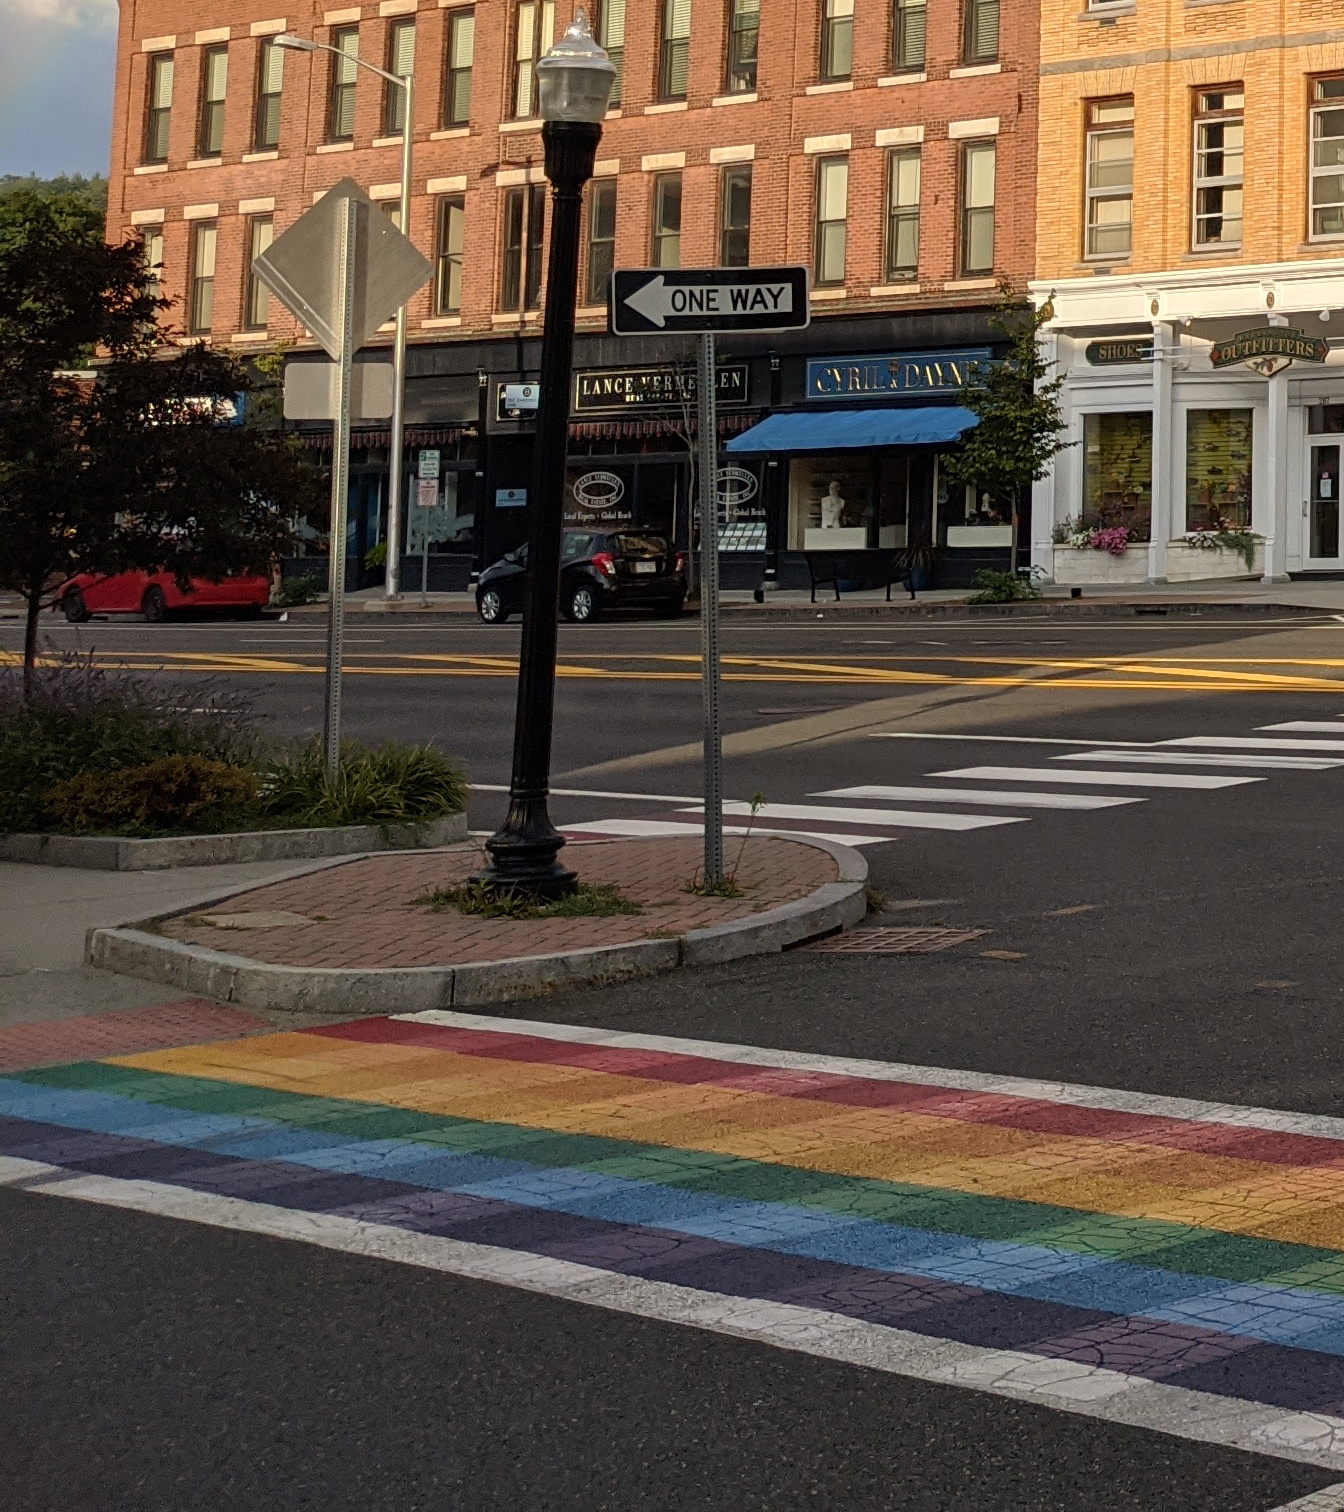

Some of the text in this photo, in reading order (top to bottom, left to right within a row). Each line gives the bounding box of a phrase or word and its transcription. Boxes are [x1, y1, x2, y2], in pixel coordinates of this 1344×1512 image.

[671, 286, 786, 313] ONE WAY
[1099, 343, 1143, 361] SHOES
[1221, 337, 1315, 362] OUTFITTERS
[583, 371, 741, 395] LANCE VERMEEN
[817, 366, 885, 392] CYRIL
